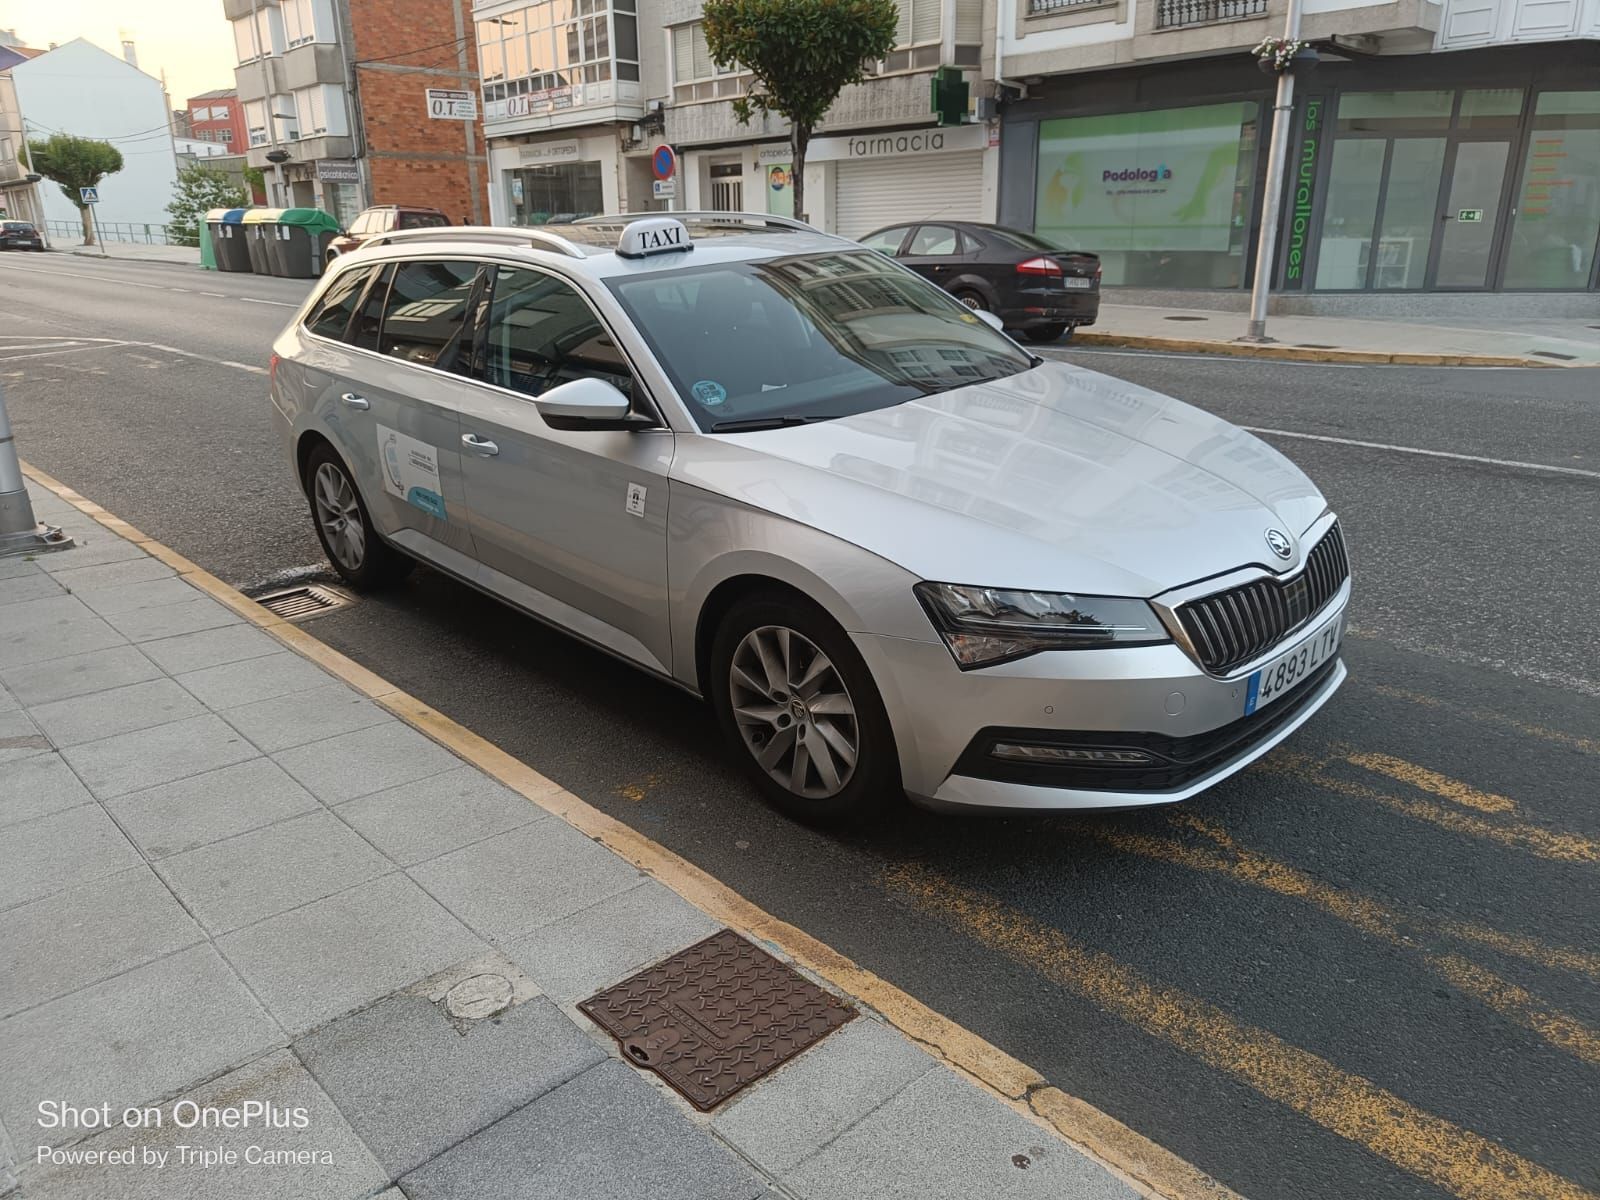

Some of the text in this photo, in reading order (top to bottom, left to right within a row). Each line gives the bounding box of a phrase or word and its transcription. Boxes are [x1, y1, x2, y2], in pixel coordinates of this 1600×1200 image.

[848, 130, 944, 156] farmacia
[1287, 101, 1321, 279] los murallones
[638, 227, 681, 250] TAXI
[1261, 648, 1308, 699] 4893
